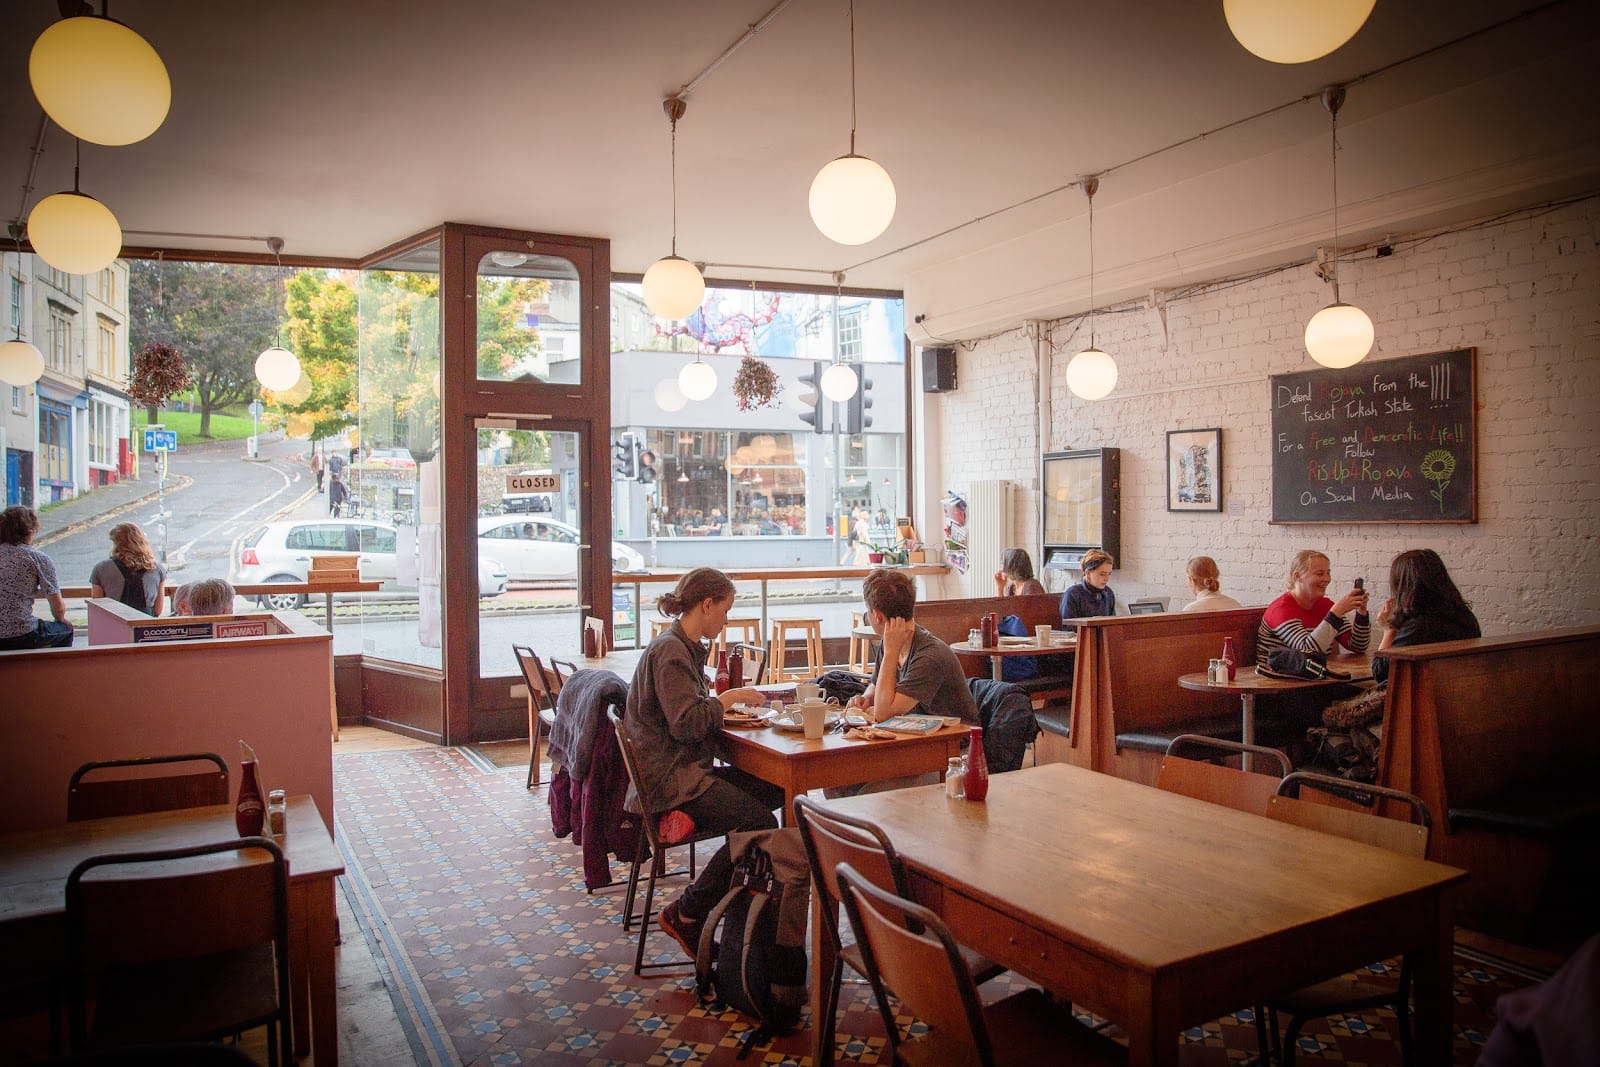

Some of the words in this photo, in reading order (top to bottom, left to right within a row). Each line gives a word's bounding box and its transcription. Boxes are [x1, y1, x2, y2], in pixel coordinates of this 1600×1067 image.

[1277, 381, 1312, 409] Defend
[1408, 372, 1429, 390] the
[1344, 400, 1377, 418] Turkish
[1384, 396, 1414, 414] State
[1278, 432, 1295, 453] For
[1297, 443, 1305, 451] a
[1309, 431, 1336, 450] Free
[1342, 430, 1359, 444] and
[1344, 442, 1376, 459] Follow
[512, 477, 555, 489] CLOSED
[1300, 491, 1318, 506] On
[1371, 485, 1414, 501] Media
[223, 625, 263, 637] AIRWAYS
